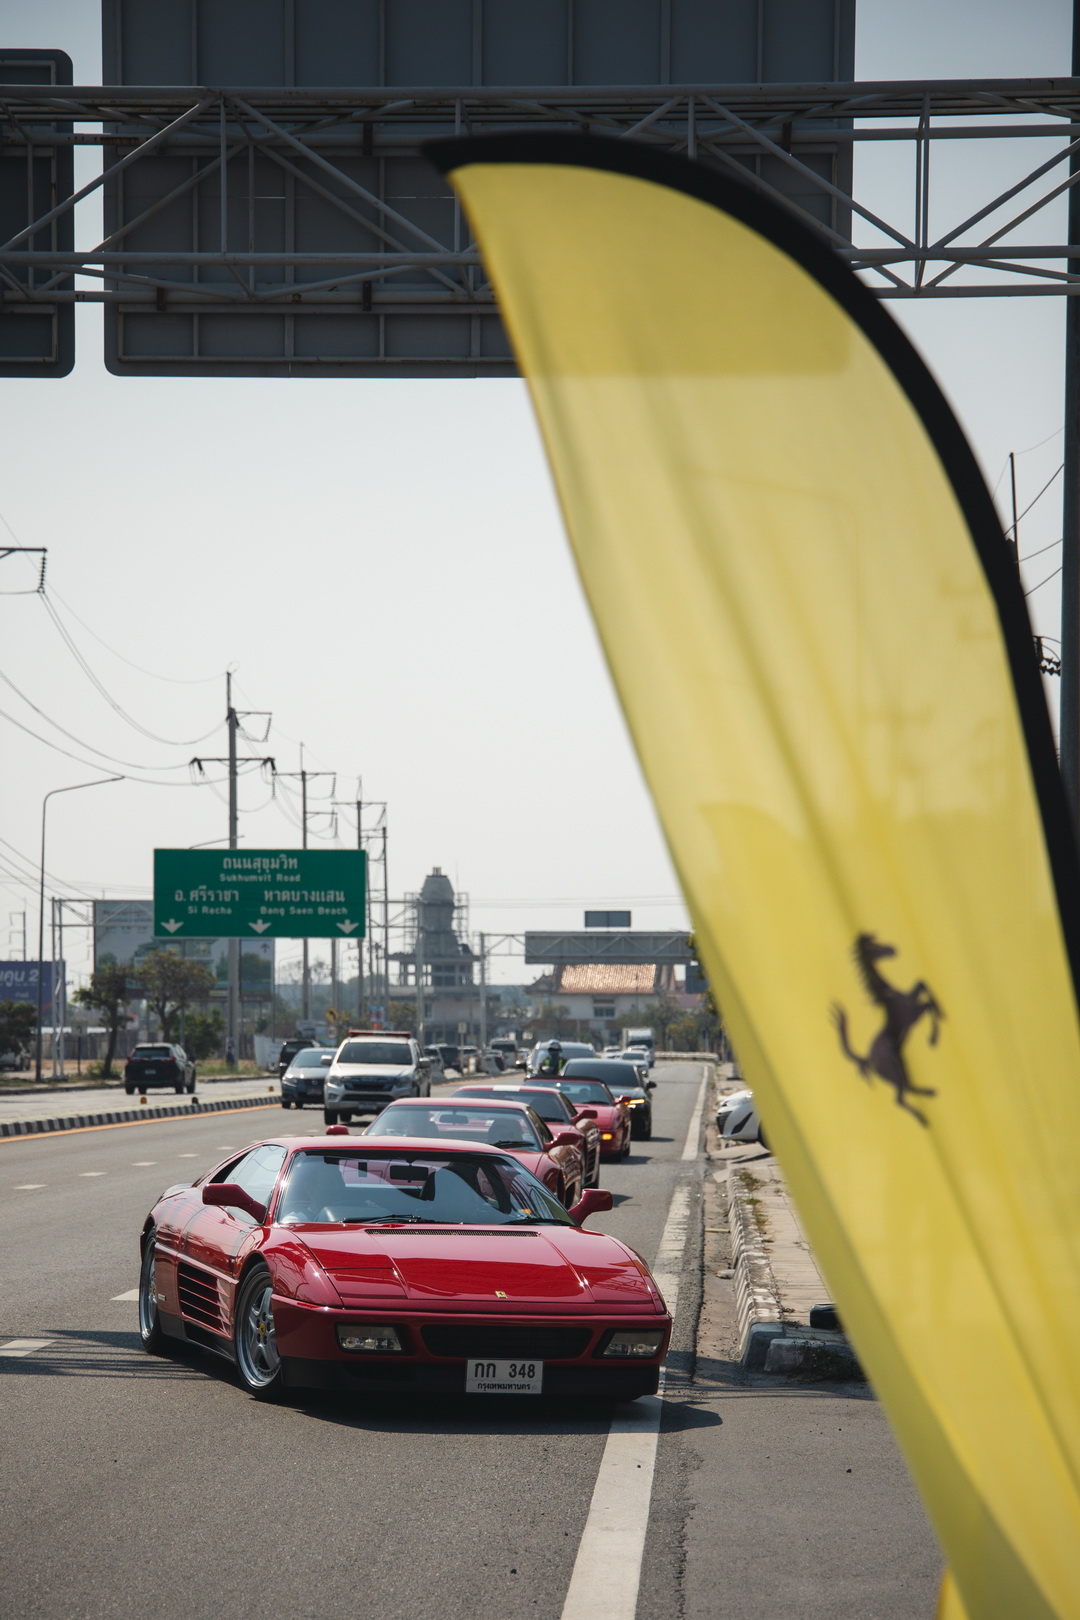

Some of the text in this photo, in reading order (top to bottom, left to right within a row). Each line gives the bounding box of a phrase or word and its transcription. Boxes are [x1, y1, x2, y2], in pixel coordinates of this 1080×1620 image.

[223, 854, 298, 873] ถนนสุขุมวิท
[220, 873, 301, 882] Sukhumvit Road
[189, 885, 239, 902] ศรีราชา
[263, 889, 345, 902] หาดบางแสน
[188, 906, 233, 915] Si Racha
[260, 906, 348, 917] Bang Saen Beach
[29, 969, 39, 982] 2
[474, 1362, 536, 1379] กก 348
[477, 1382, 531, 1392] กรุงเทพมหานคร
